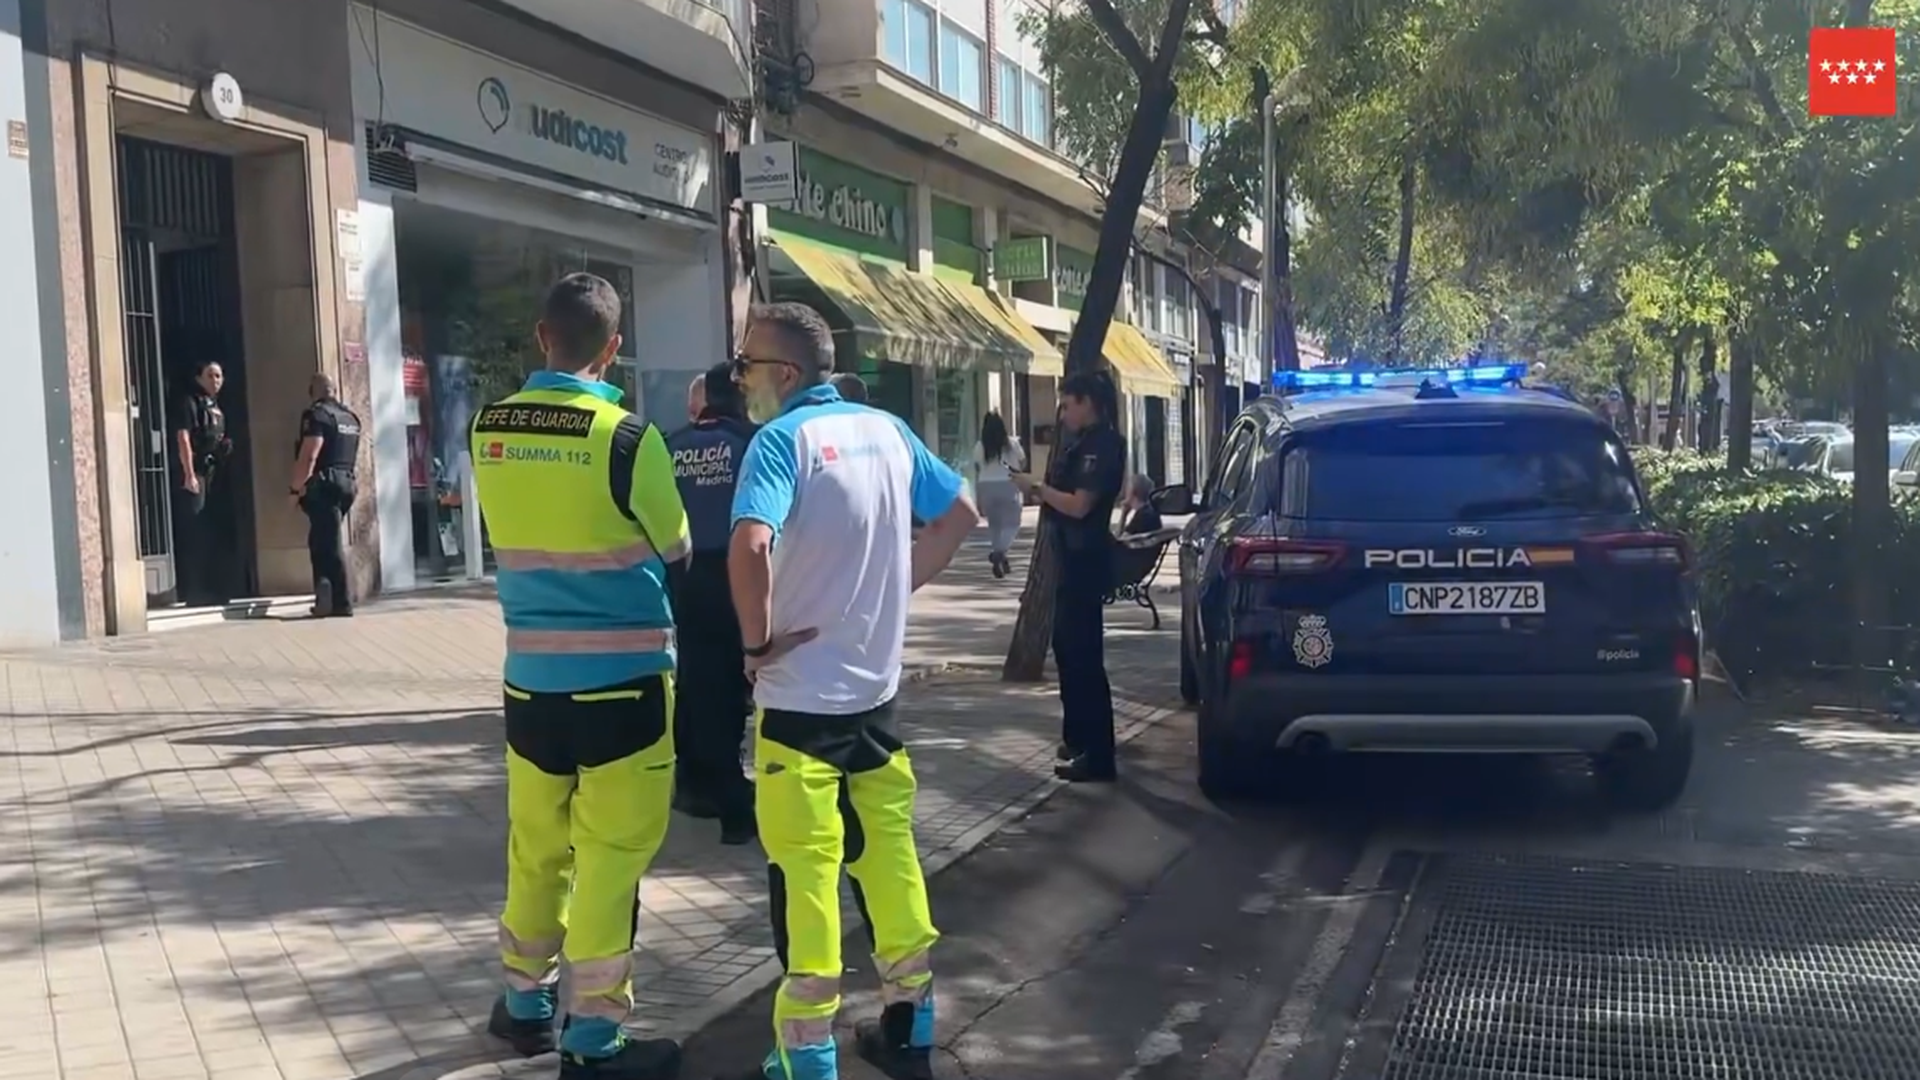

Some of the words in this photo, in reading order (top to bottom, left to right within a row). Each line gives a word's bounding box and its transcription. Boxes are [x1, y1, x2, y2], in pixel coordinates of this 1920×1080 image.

[220, 87, 234, 104] 30
[480, 408, 510, 426] JEFE
[510, 409, 531, 426] DE
[531, 410, 591, 431] GUARDIA
[506, 447, 562, 462] SUMMA
[567, 451, 592, 465] 112
[673, 440, 732, 464] POLICÍA
[696, 473, 733, 486] Madrid
[1364, 548, 1531, 568] POLICIA
[1405, 586, 1539, 610] CNP2187ZB
